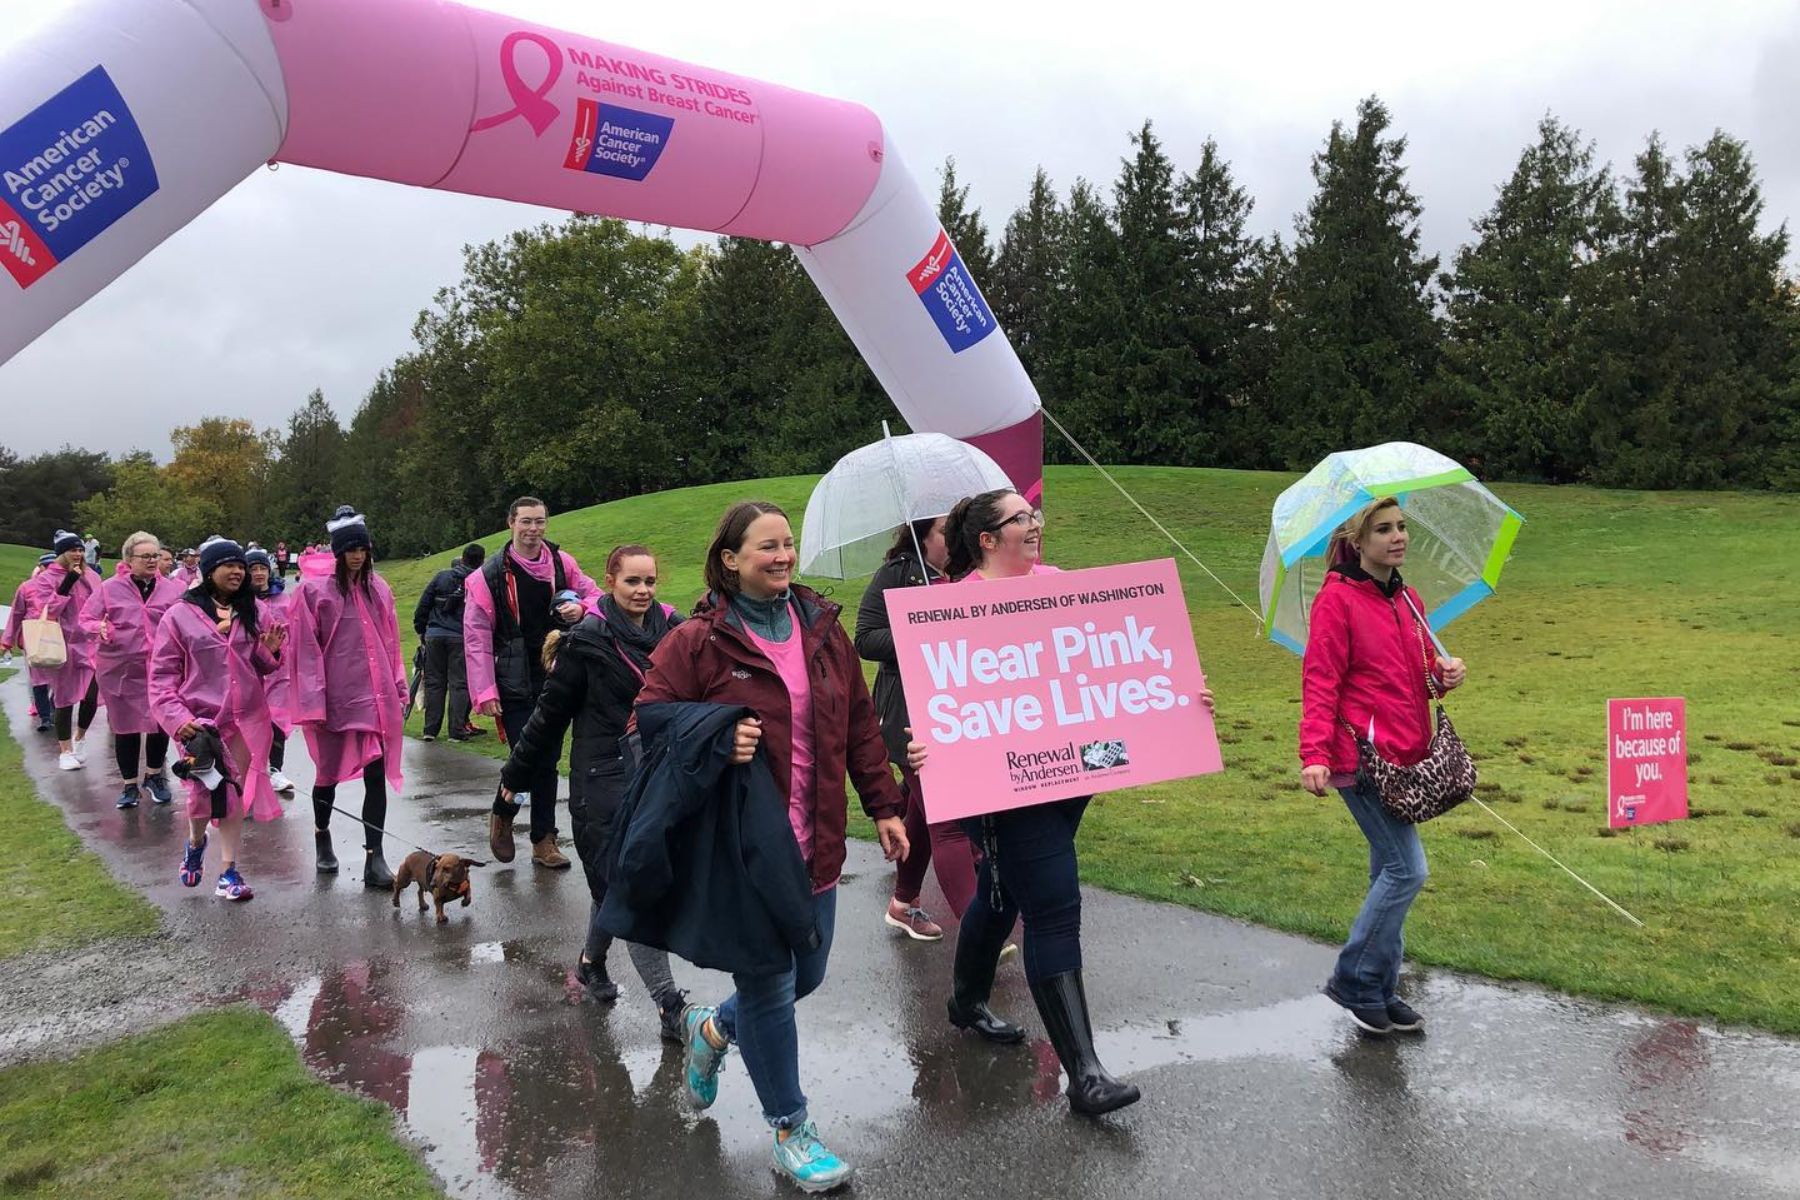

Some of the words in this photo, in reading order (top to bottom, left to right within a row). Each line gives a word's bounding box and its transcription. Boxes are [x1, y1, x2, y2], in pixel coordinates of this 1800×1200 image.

[568, 48, 666, 85] MAKING
[670, 73, 752, 105] STRIDES
[577, 71, 644, 99] Against
[647, 87, 701, 112] Breast
[704, 101, 756, 124] Cancer
[3, 110, 116, 194] American
[598, 134, 641, 153] Cancer
[600, 121, 660, 144] American
[20, 147, 103, 210] Cancer
[945, 273, 973, 318] Cancer
[950, 266, 987, 327] American
[907, 606, 969, 625] RENEWAL
[970, 604, 987, 618] BY
[991, 597, 1057, 616] ANDERSEN
[1060, 594, 1076, 607] OF
[1077, 583, 1165, 605] WASHINGTON
[920, 639, 1044, 690] Wear
[1051, 615, 1173, 673] Pink,
[927, 694, 1044, 744] Save
[1049, 674, 1190, 727] Lives.
[1623, 707, 1644, 731] I'm
[1645, 705, 1673, 730] here
[1006, 741, 1076, 770] Renewal
[1615, 733, 1666, 759] because
[1668, 730, 1681, 755] of
[1013, 784, 1037, 792] WINDOW
[1040, 777, 1080, 788] REPLACEMENT
[1635, 762, 1663, 788] you.
